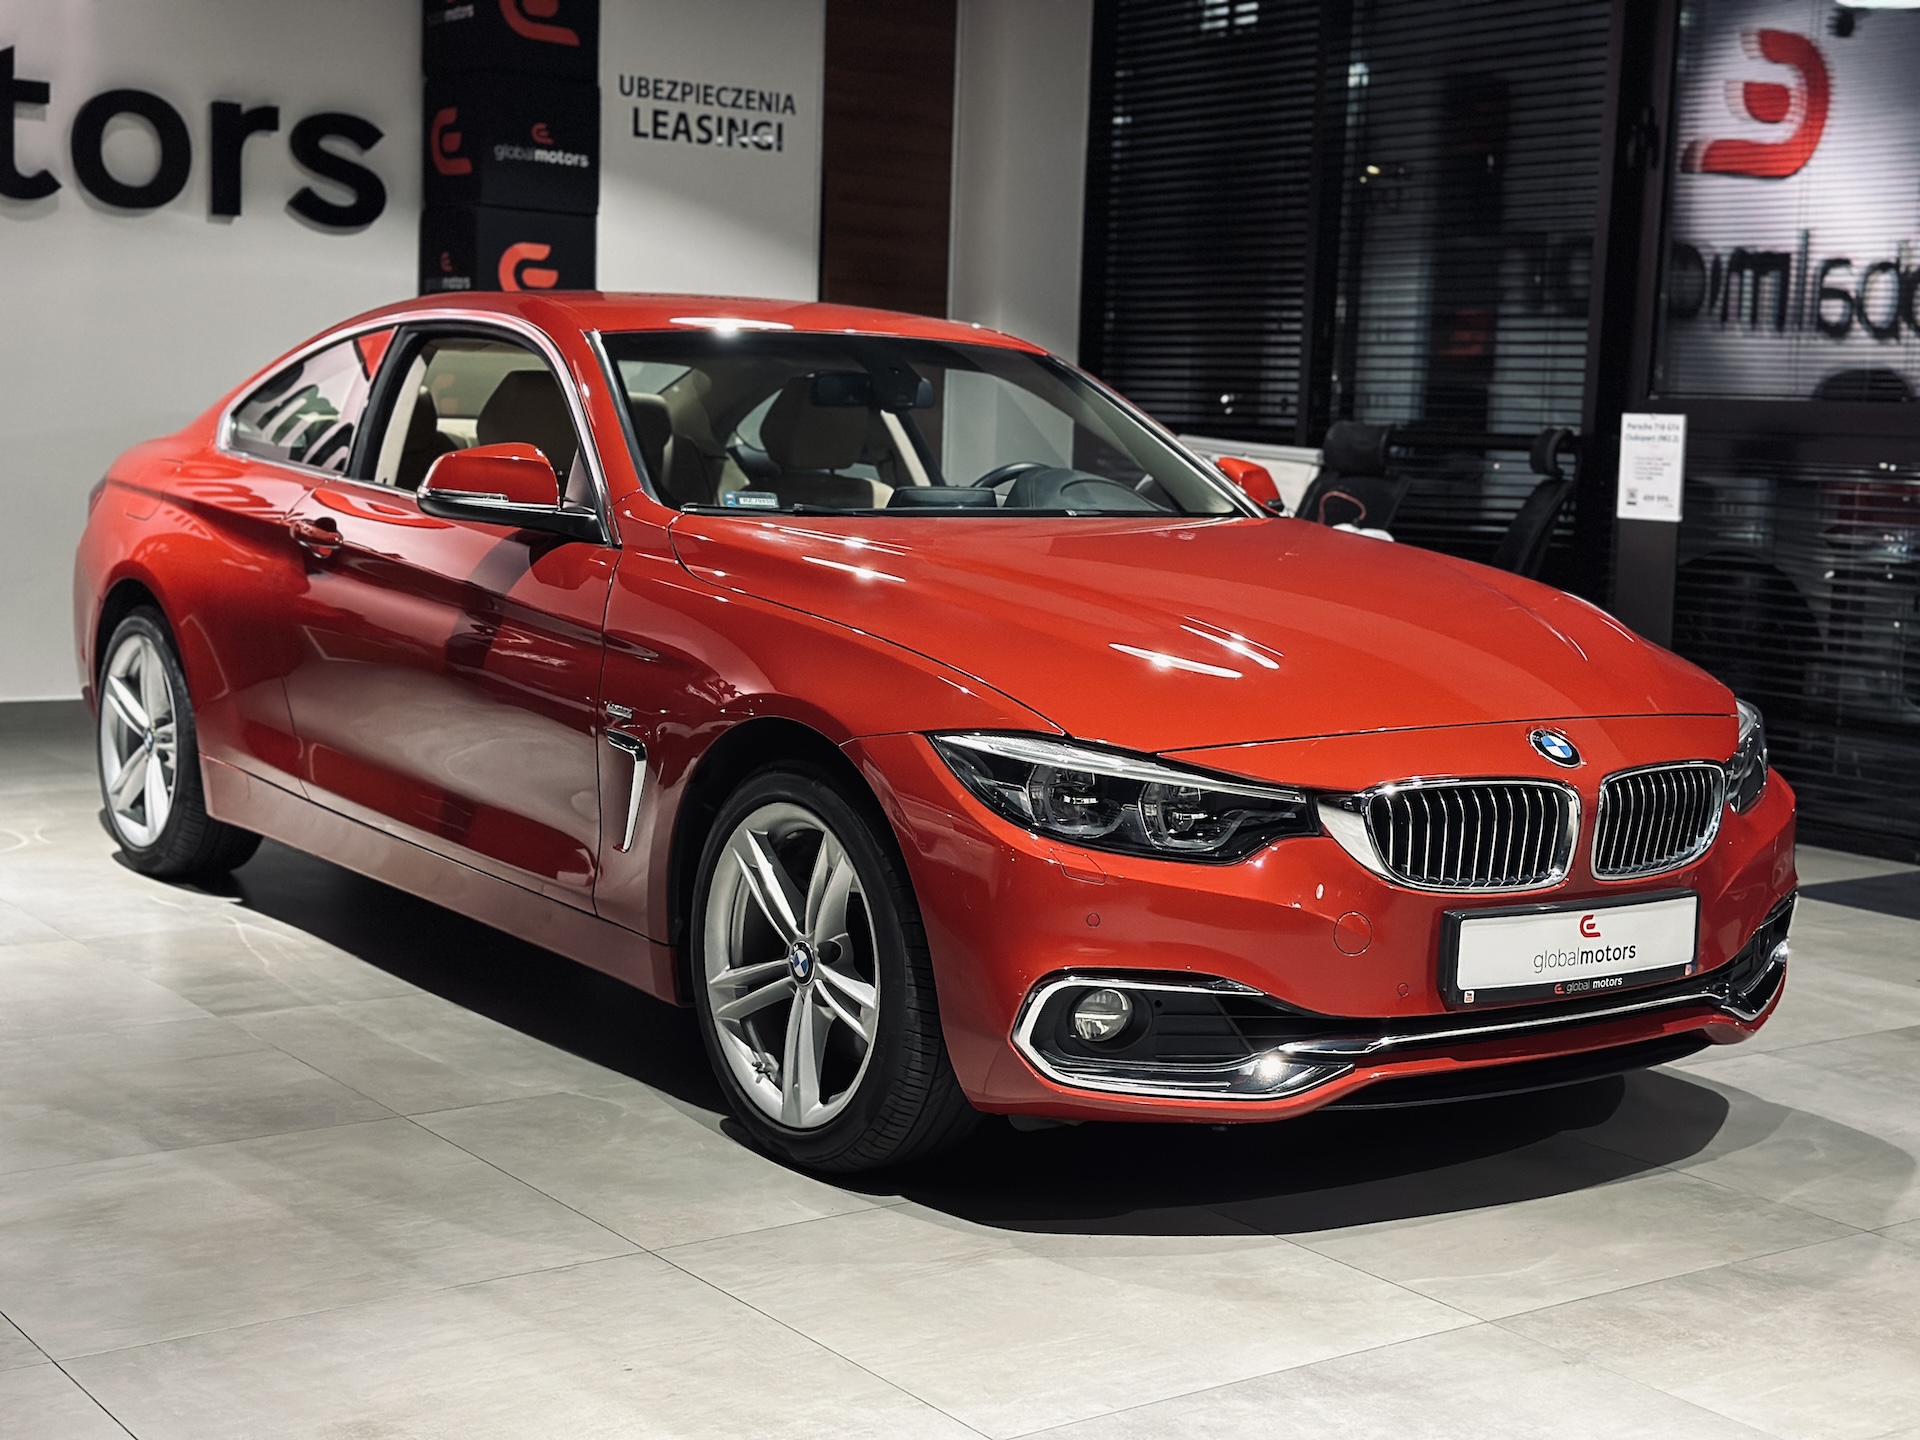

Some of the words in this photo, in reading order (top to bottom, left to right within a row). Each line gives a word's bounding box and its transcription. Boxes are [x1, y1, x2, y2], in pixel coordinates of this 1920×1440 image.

[619, 74, 796, 115] UBEZPIECZENIA
[0, 45, 387, 228] tors
[1533, 944, 1636, 974] globalmotors
[1566, 980, 1590, 994] global
[1592, 977, 1623, 989] motors
